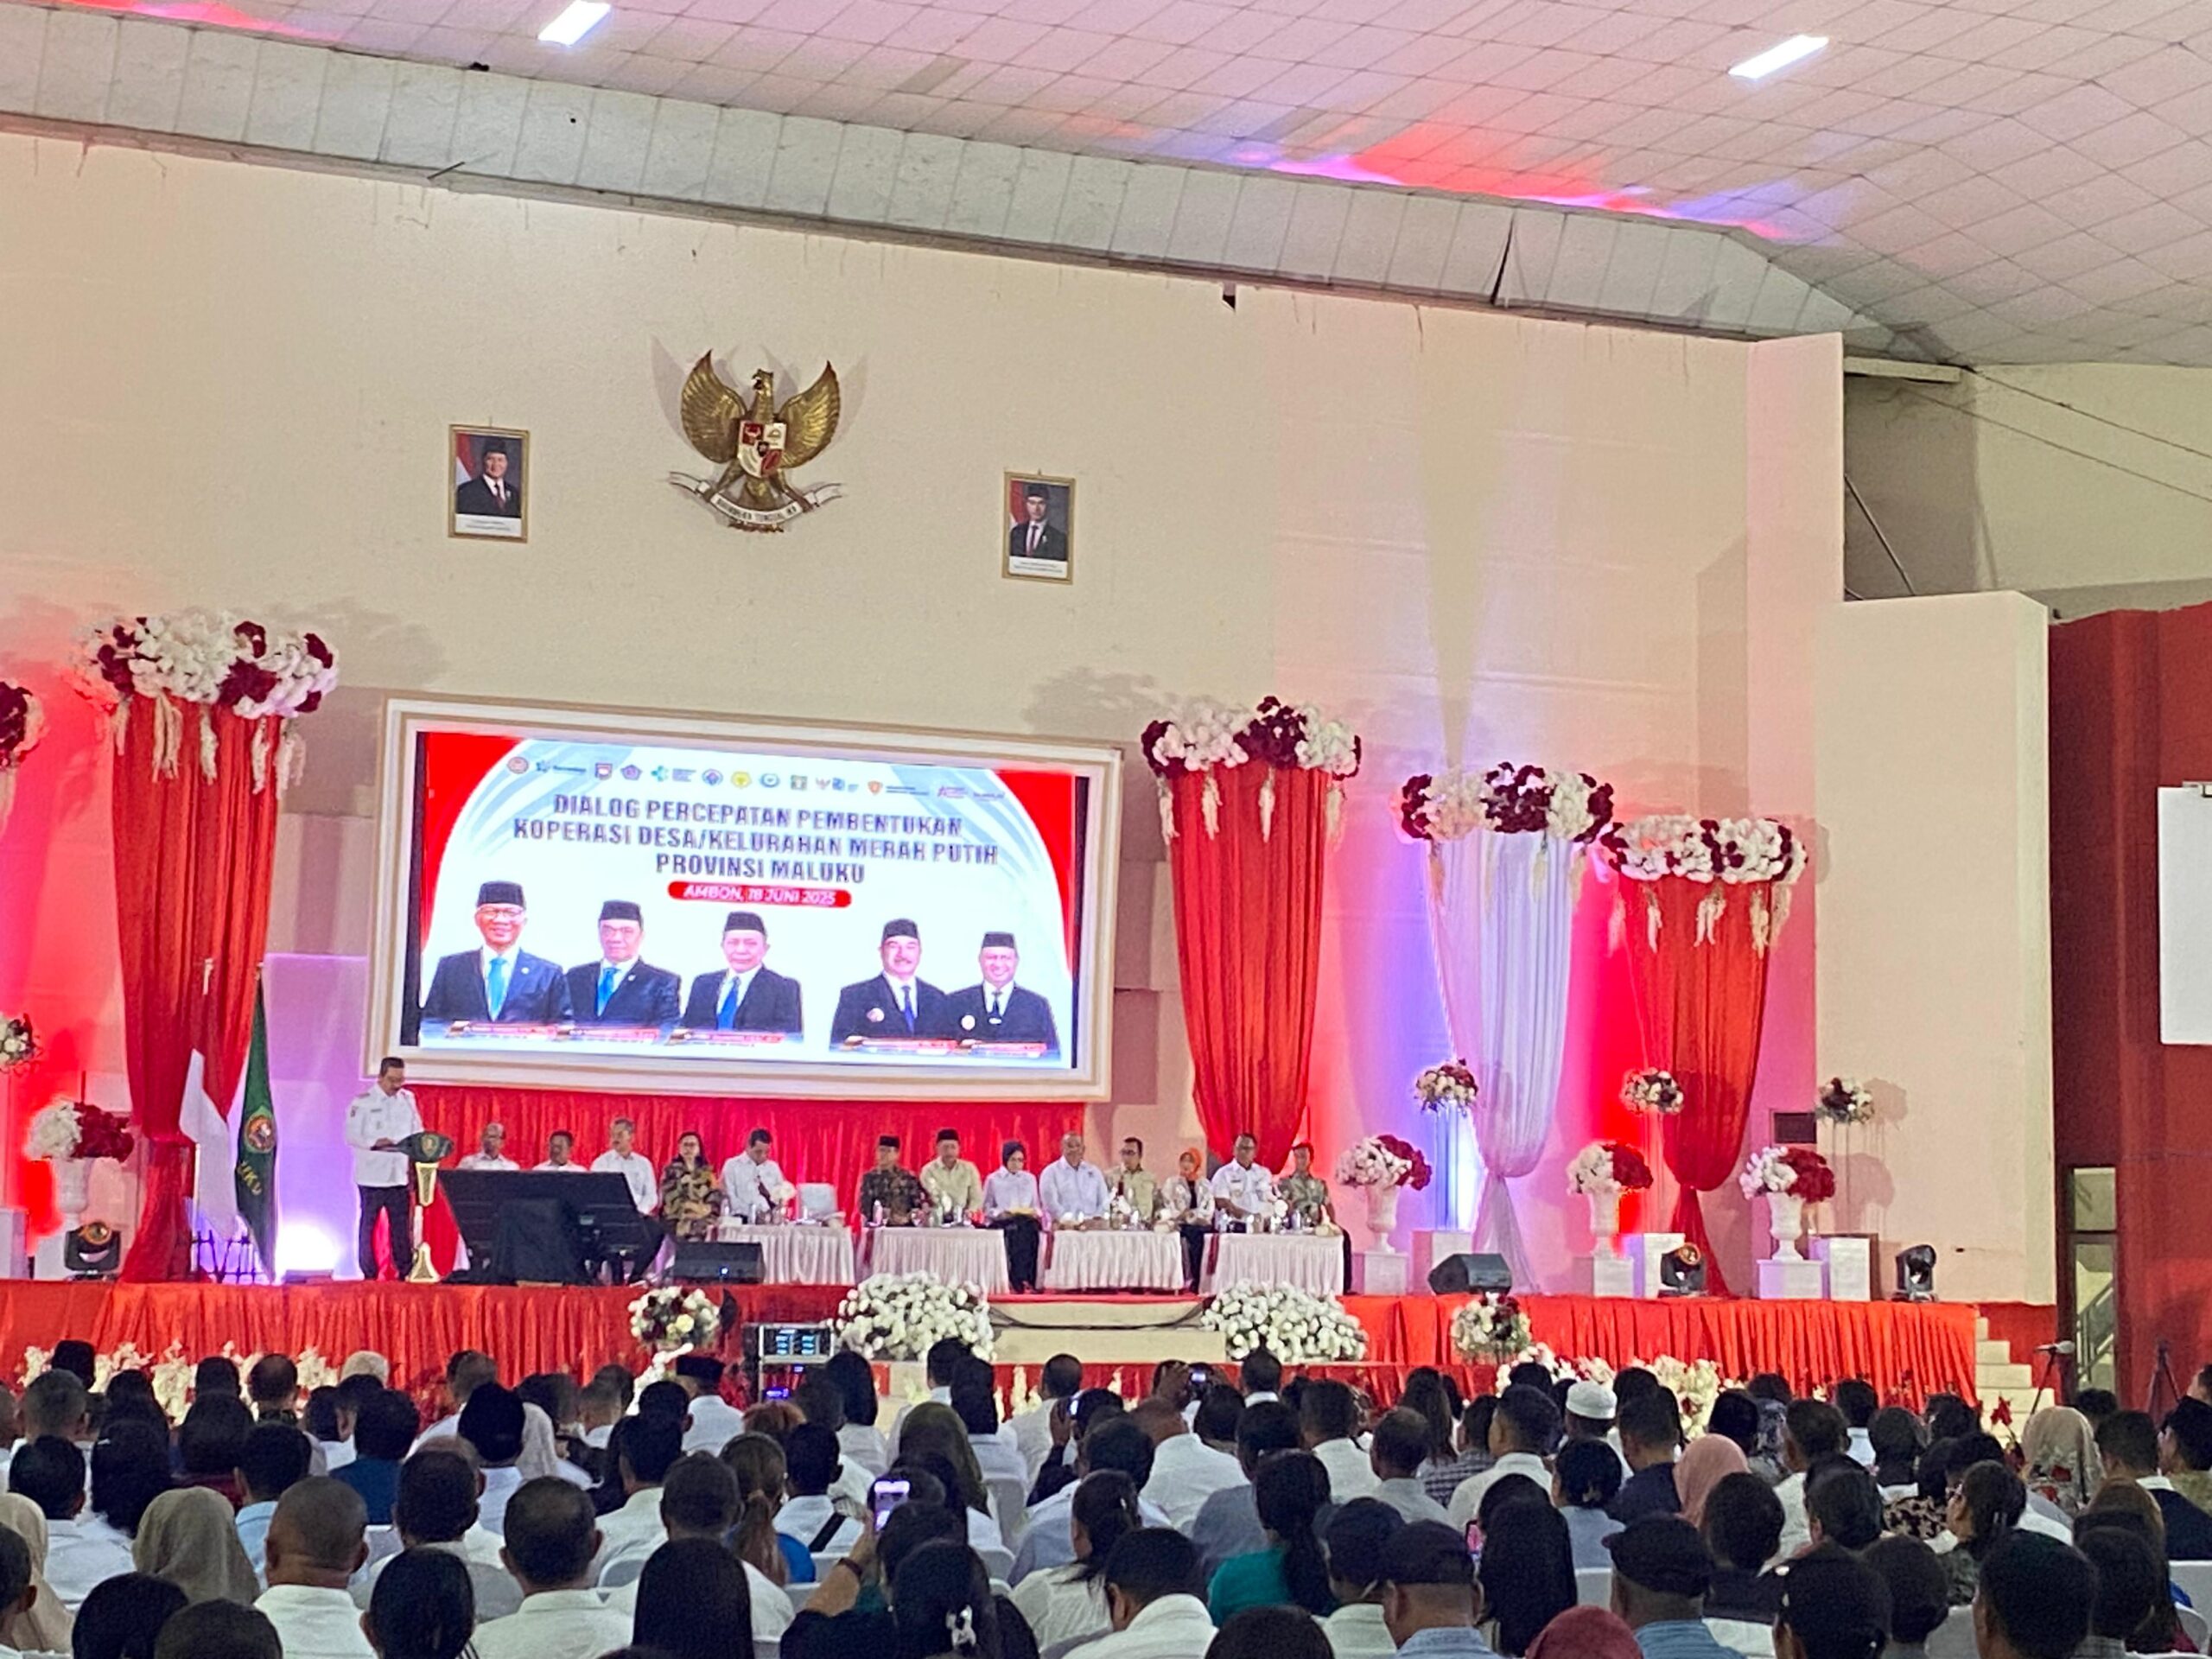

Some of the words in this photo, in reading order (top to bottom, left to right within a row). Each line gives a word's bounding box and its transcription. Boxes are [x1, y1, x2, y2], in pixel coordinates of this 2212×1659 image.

[554, 794, 640, 818] DIALOG
[646, 800, 791, 828] PERCEPATAN
[797, 809, 963, 836] PEMBENTUKAN
[513, 818, 632, 844] KOPERASI
[639, 826, 842, 855] DESA/KELURAHAN
[849, 836, 927, 861] MERAH
[932, 842, 998, 865] PUTIH
[656, 853, 765, 878] PROVINSI
[770, 860, 865, 883] MALUKU
[683, 885, 744, 901] AMBON,
[765, 888, 800, 903] JUNI
[801, 890, 836, 906] 2025
